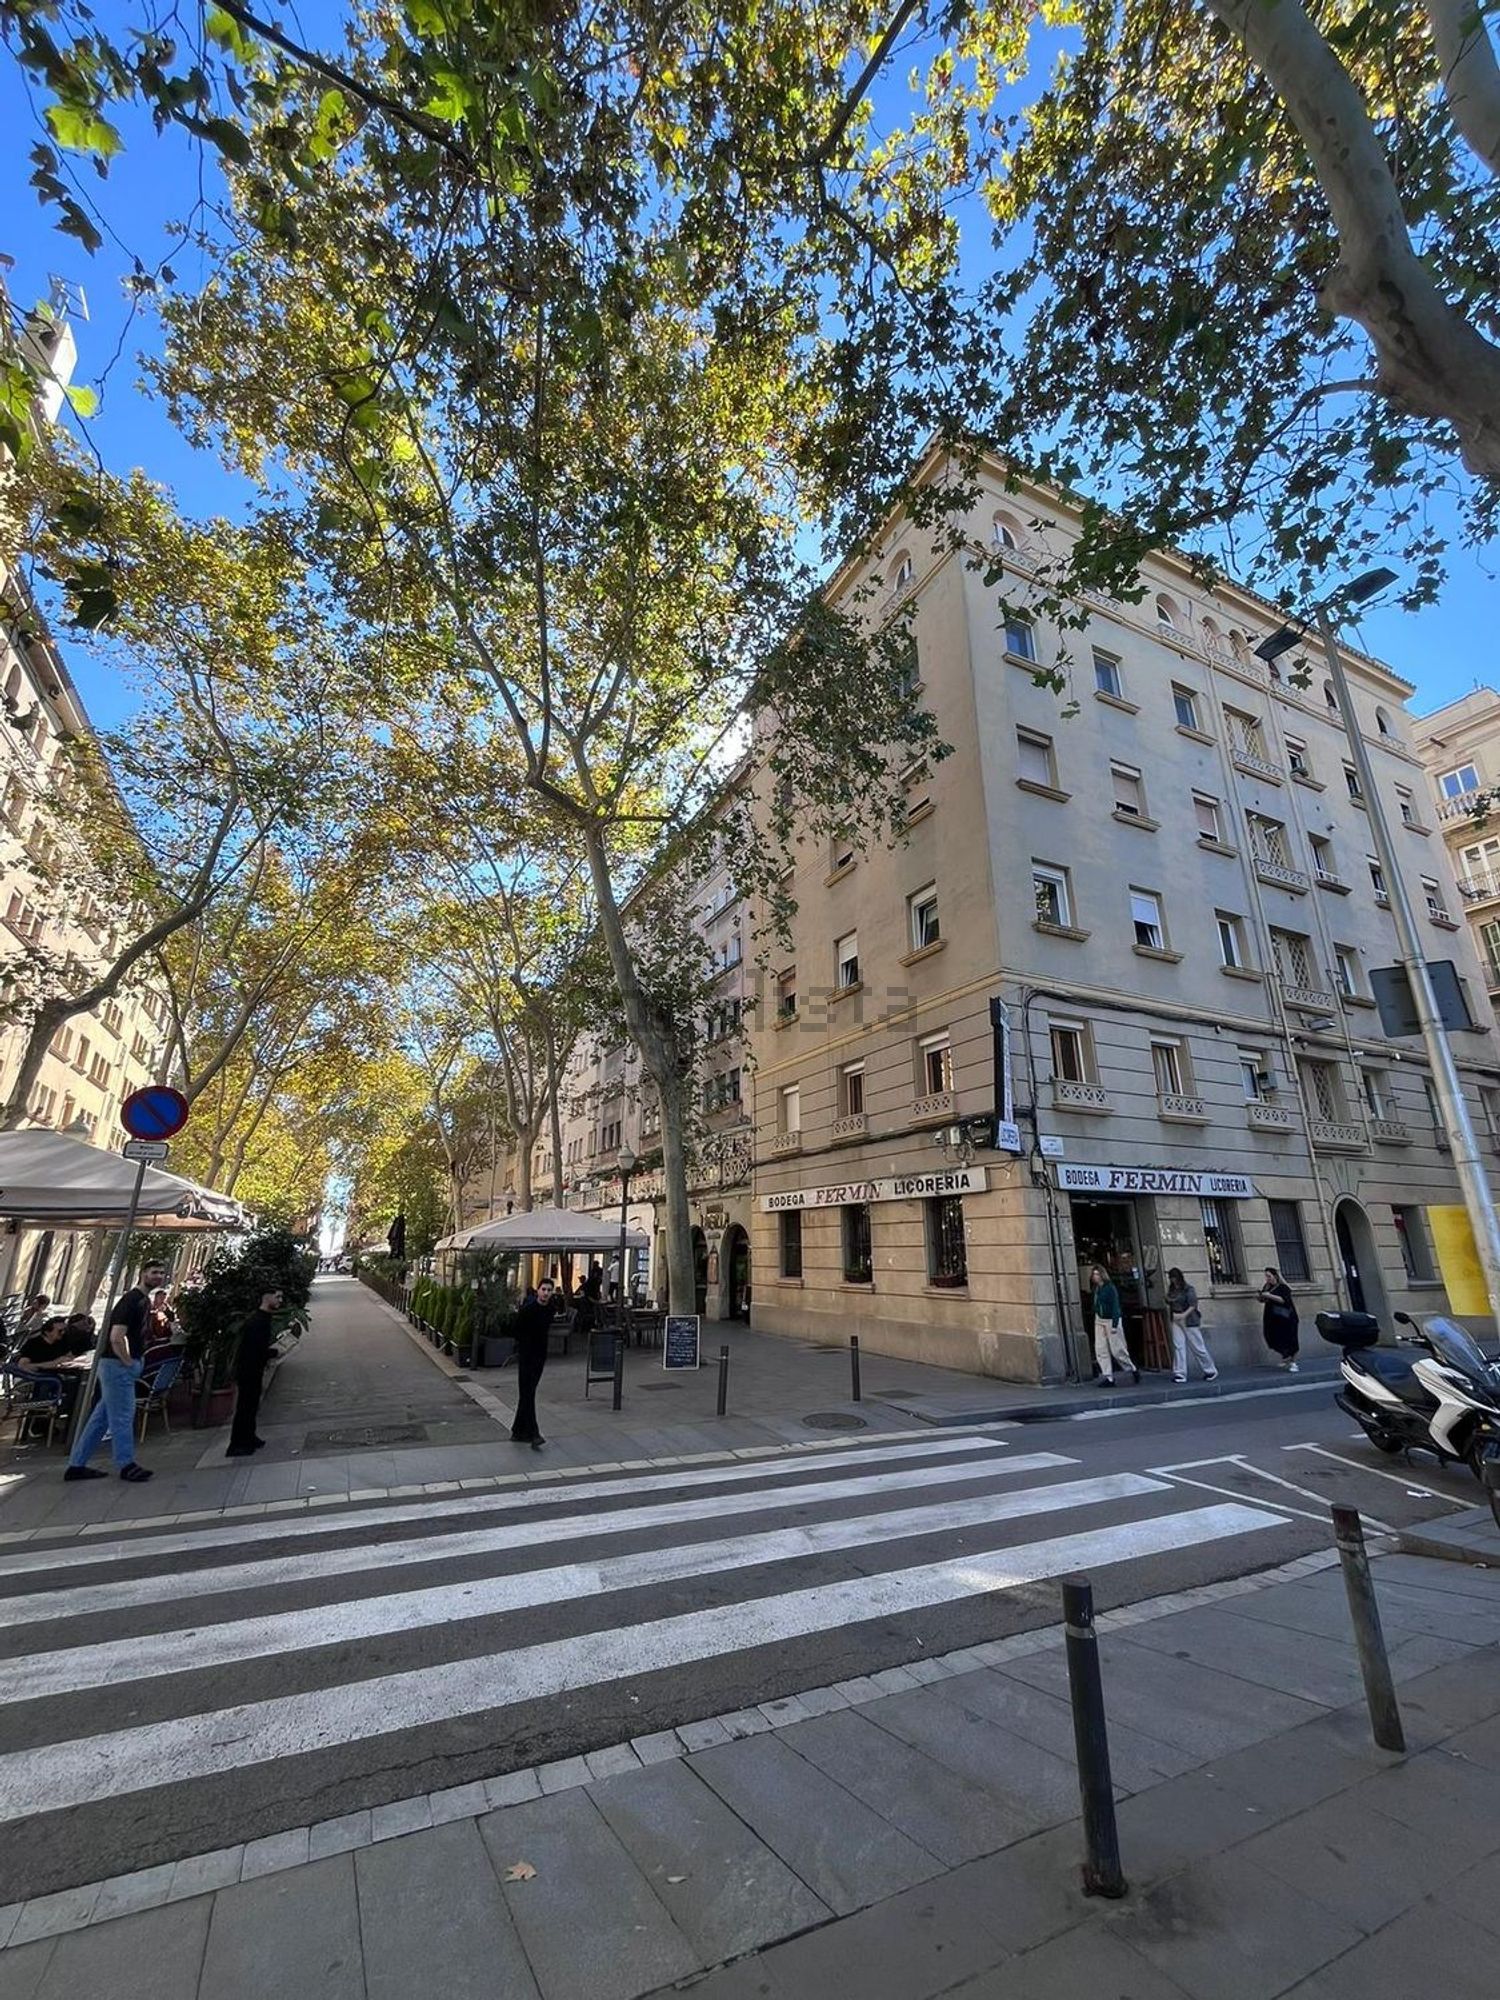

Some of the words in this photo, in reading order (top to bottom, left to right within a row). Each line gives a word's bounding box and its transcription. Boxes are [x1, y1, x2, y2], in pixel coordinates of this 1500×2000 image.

[768, 1193, 805, 1208] BODEGA
[814, 1182, 883, 1205] FERMIN
[894, 1173, 971, 1196] LICORERIA
[1065, 1169, 1100, 1186] BODEGA
[1108, 1170, 1203, 1192] FERMIN
